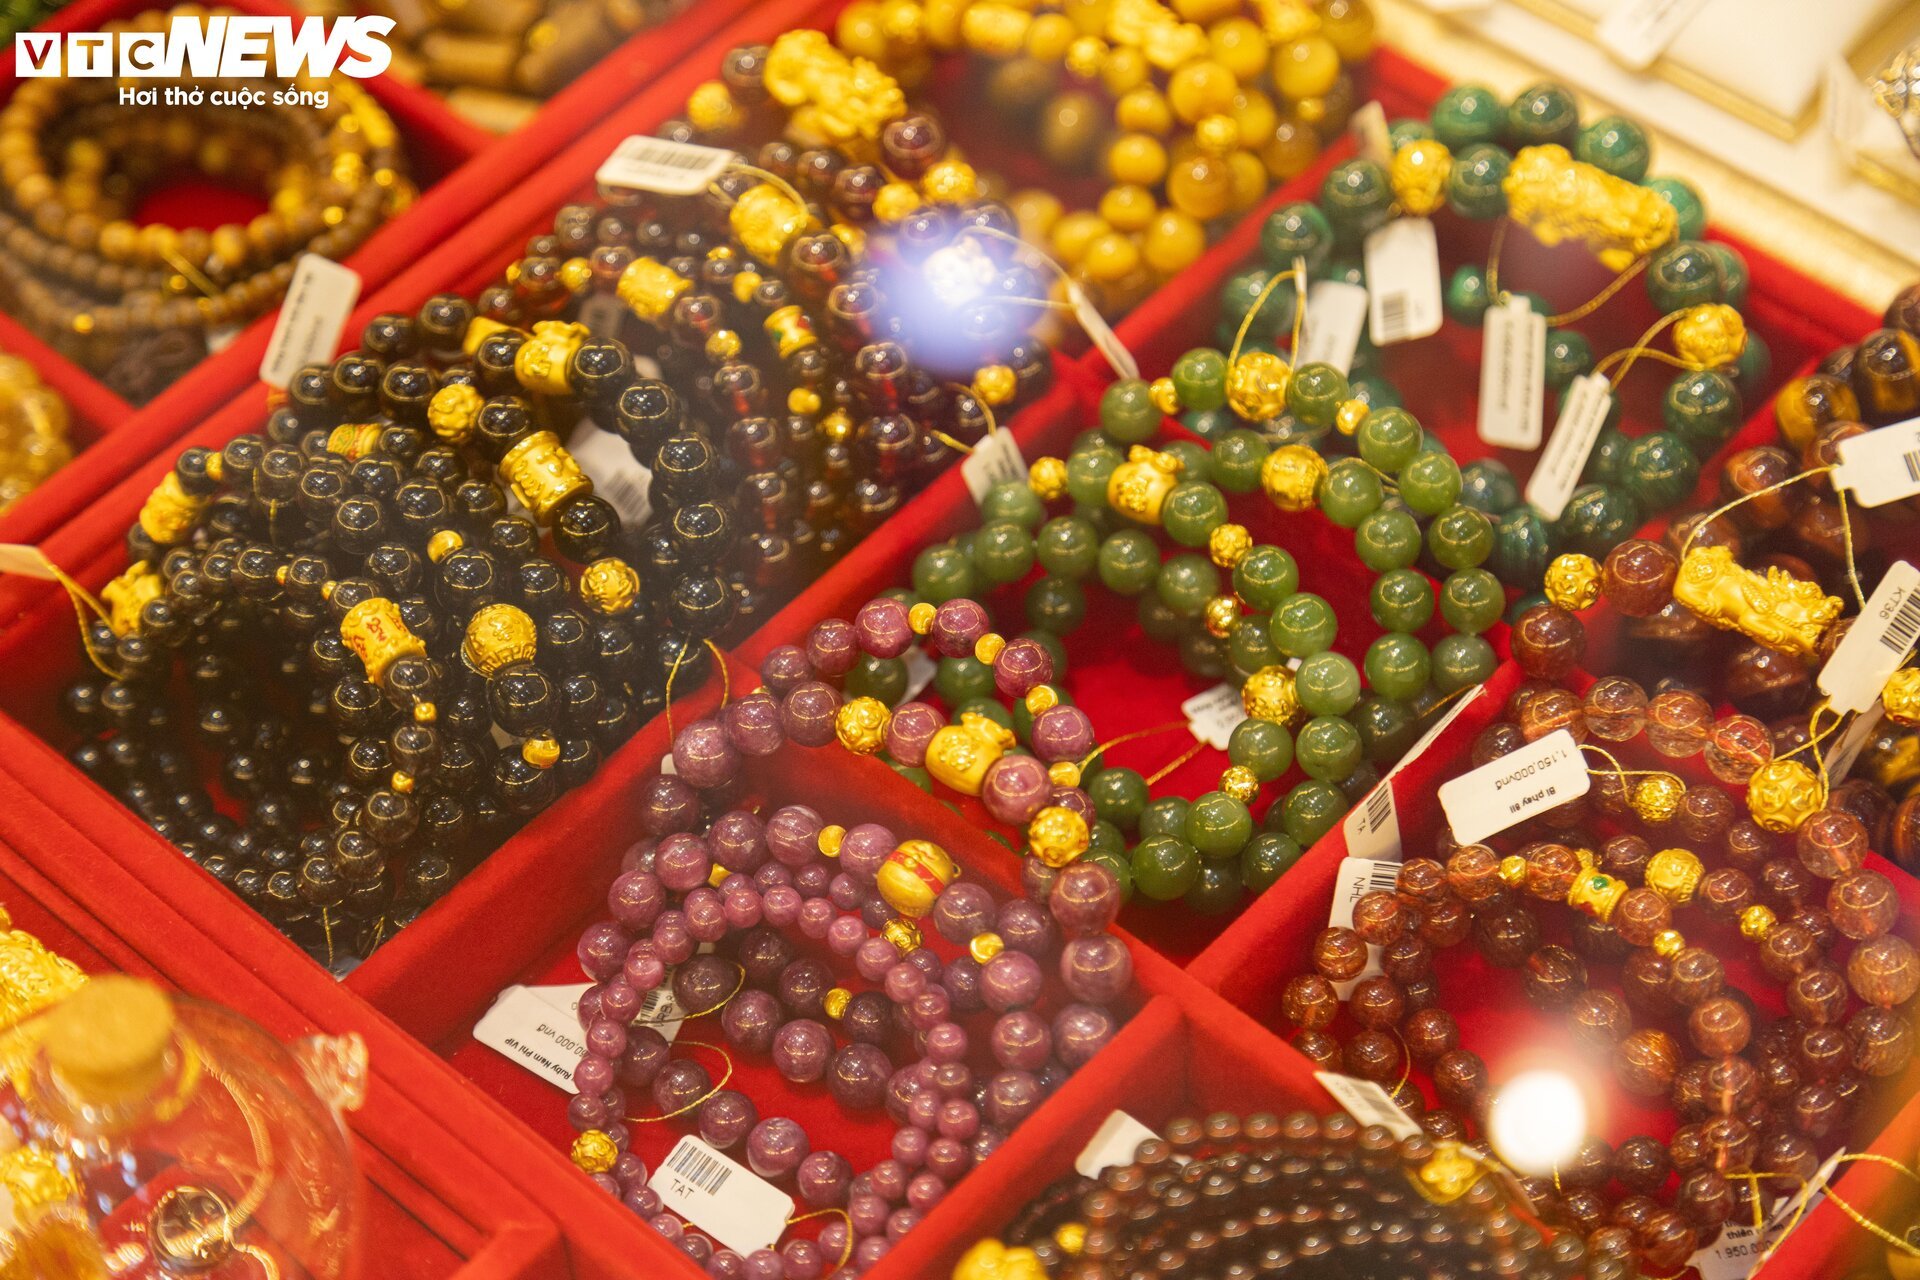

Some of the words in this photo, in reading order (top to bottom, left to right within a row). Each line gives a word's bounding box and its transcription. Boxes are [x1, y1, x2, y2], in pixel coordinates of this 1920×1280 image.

[533, 1053, 552, 1069] Nam
[551, 1064, 572, 1080] Ruby
[670, 1178, 695, 1199] TAT
